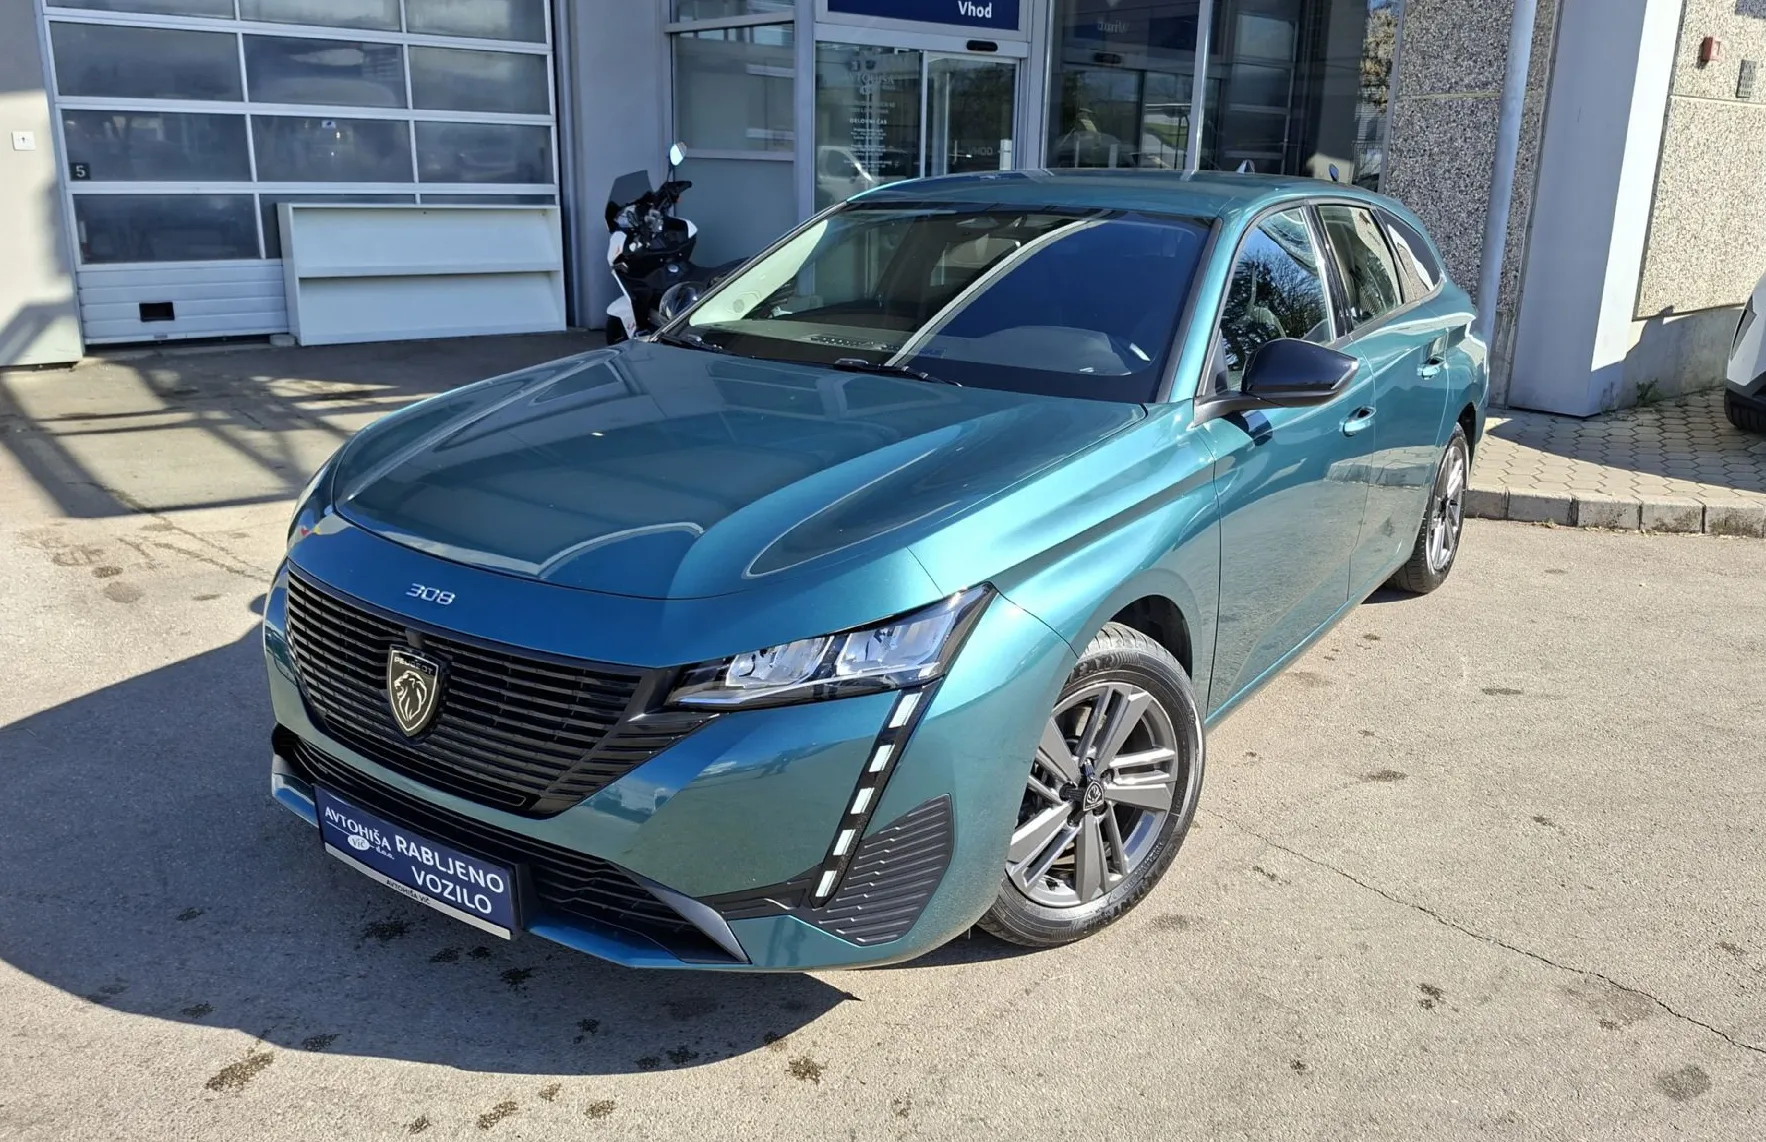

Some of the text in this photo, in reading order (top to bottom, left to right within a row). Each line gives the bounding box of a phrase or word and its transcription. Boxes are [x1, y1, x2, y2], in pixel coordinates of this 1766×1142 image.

[958, 0, 992, 19] Vhod
[76, 164, 86, 178] 5
[405, 582, 456, 606] 308
[325, 806, 392, 852] AVTOHIŠA
[395, 834, 505, 894] RABLJENO
[411, 865, 493, 915] VOZILO
